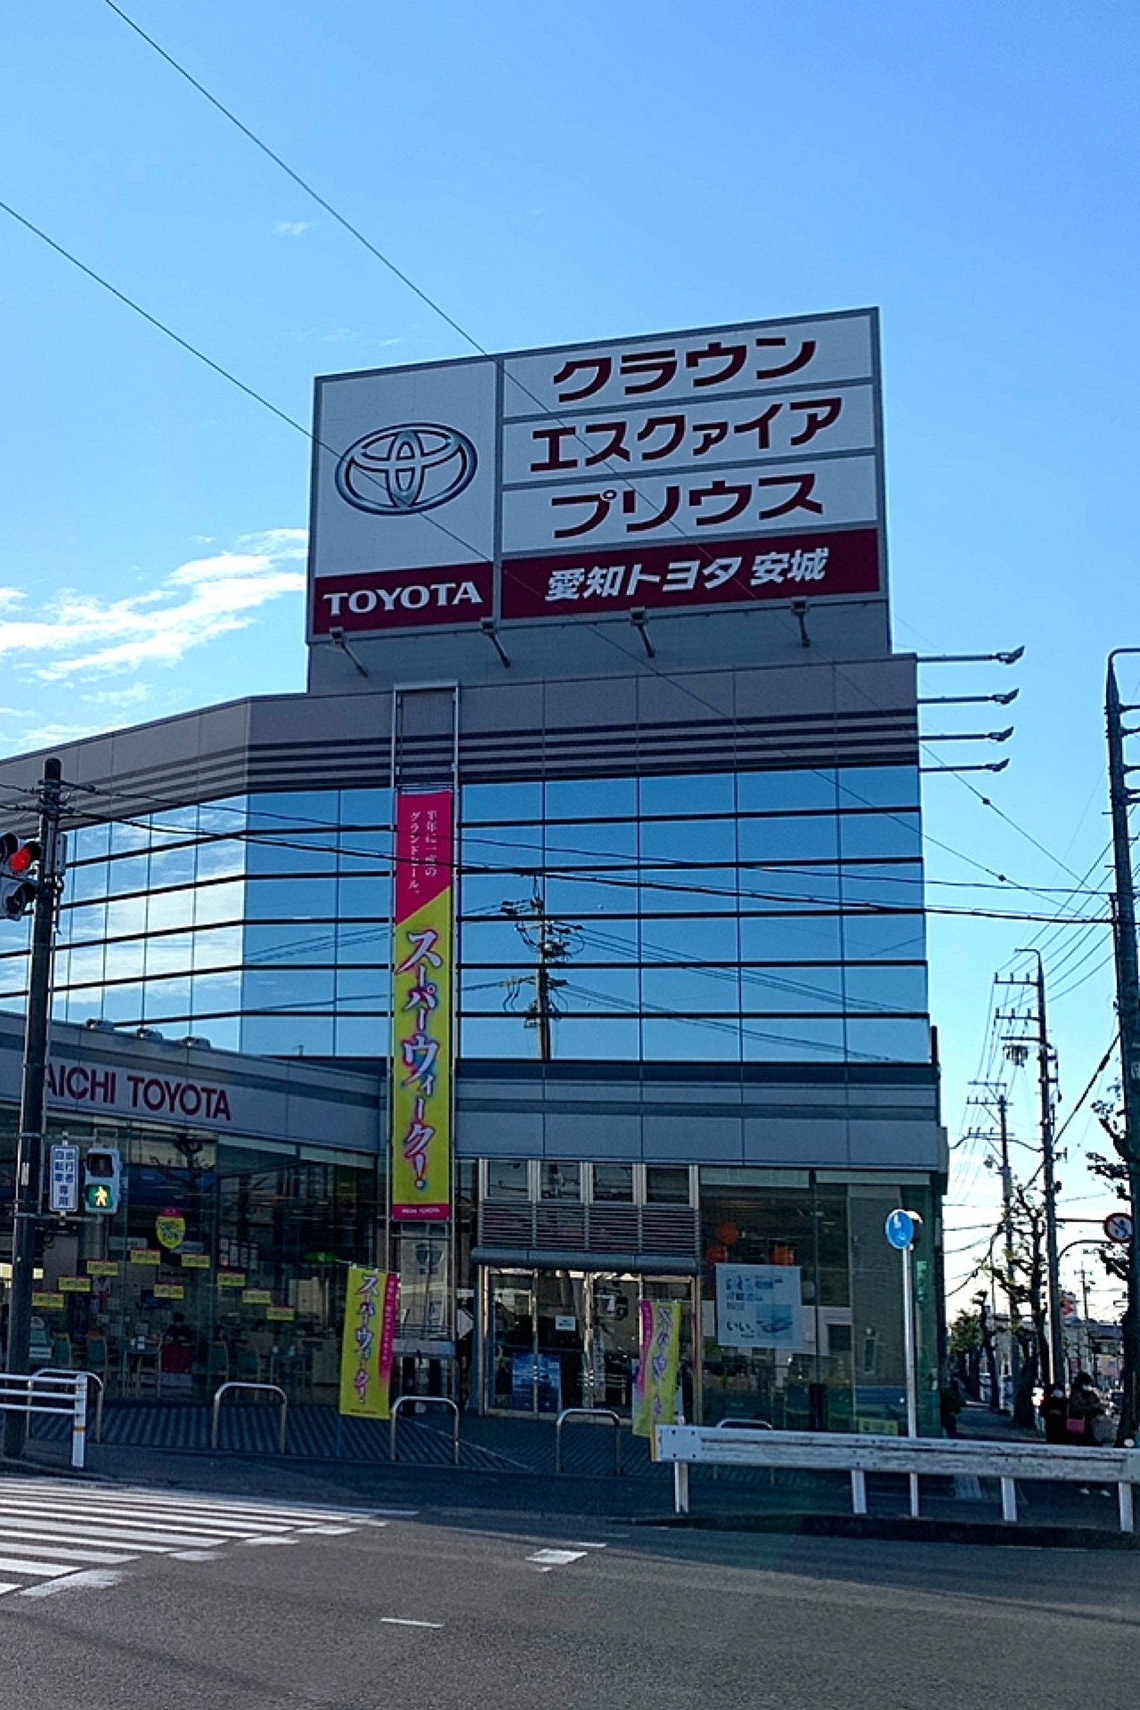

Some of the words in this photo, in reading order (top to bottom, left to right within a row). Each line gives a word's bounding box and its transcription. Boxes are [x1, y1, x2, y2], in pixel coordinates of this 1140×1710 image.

[553, 337, 817, 403] クラウン
[530, 397, 842, 473] エスクァイア
[551, 473, 823, 539] プリウス
[323, 579, 483, 616] TOYOTA
[545, 554, 743, 601] 愛知トヨタ
[750, 547, 830, 586] 安城
[127, 1075, 231, 1121] TOYOTA
